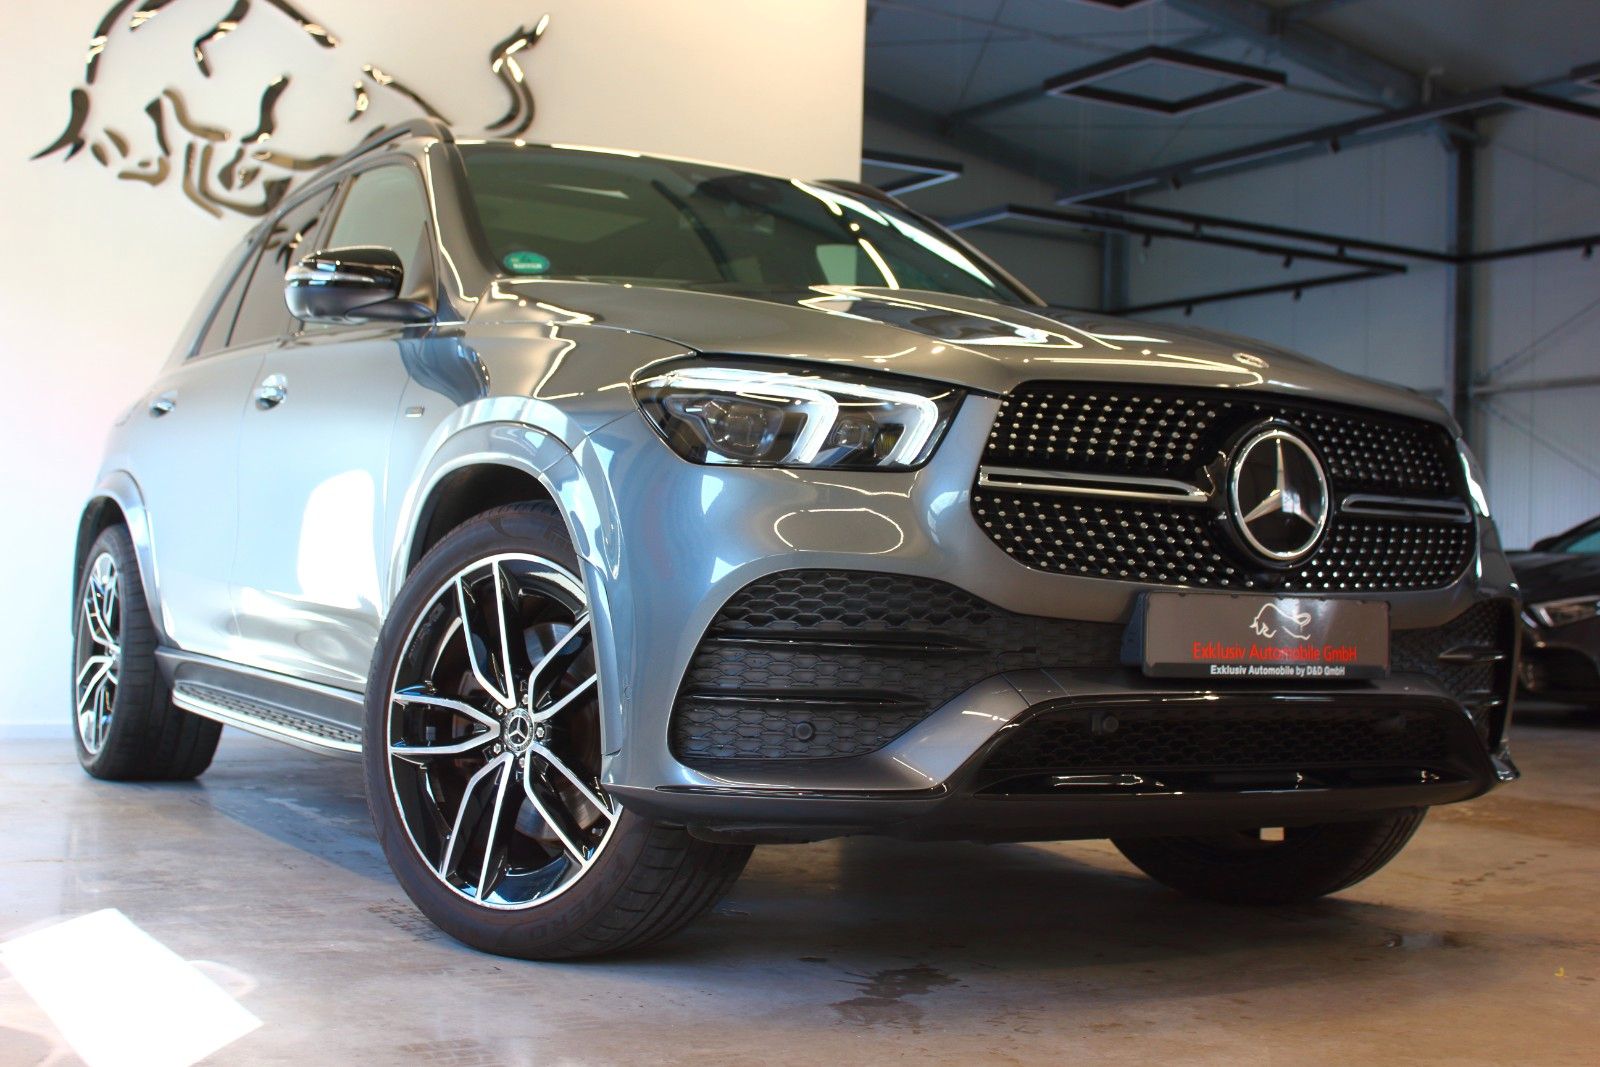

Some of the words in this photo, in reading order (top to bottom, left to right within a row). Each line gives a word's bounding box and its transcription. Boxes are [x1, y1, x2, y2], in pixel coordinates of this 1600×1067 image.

[1193, 641, 1246, 660] Exklusiv
[1249, 643, 1320, 661] Automobile
[1322, 643, 1358, 662] GmbH
[1210, 664, 1247, 675] Exklusiv
[1248, 665, 1294, 676] Automobile
[1295, 665, 1306, 678] by
[1306, 665, 1323, 676] D&D
[1324, 666, 1346, 676] GmbH
